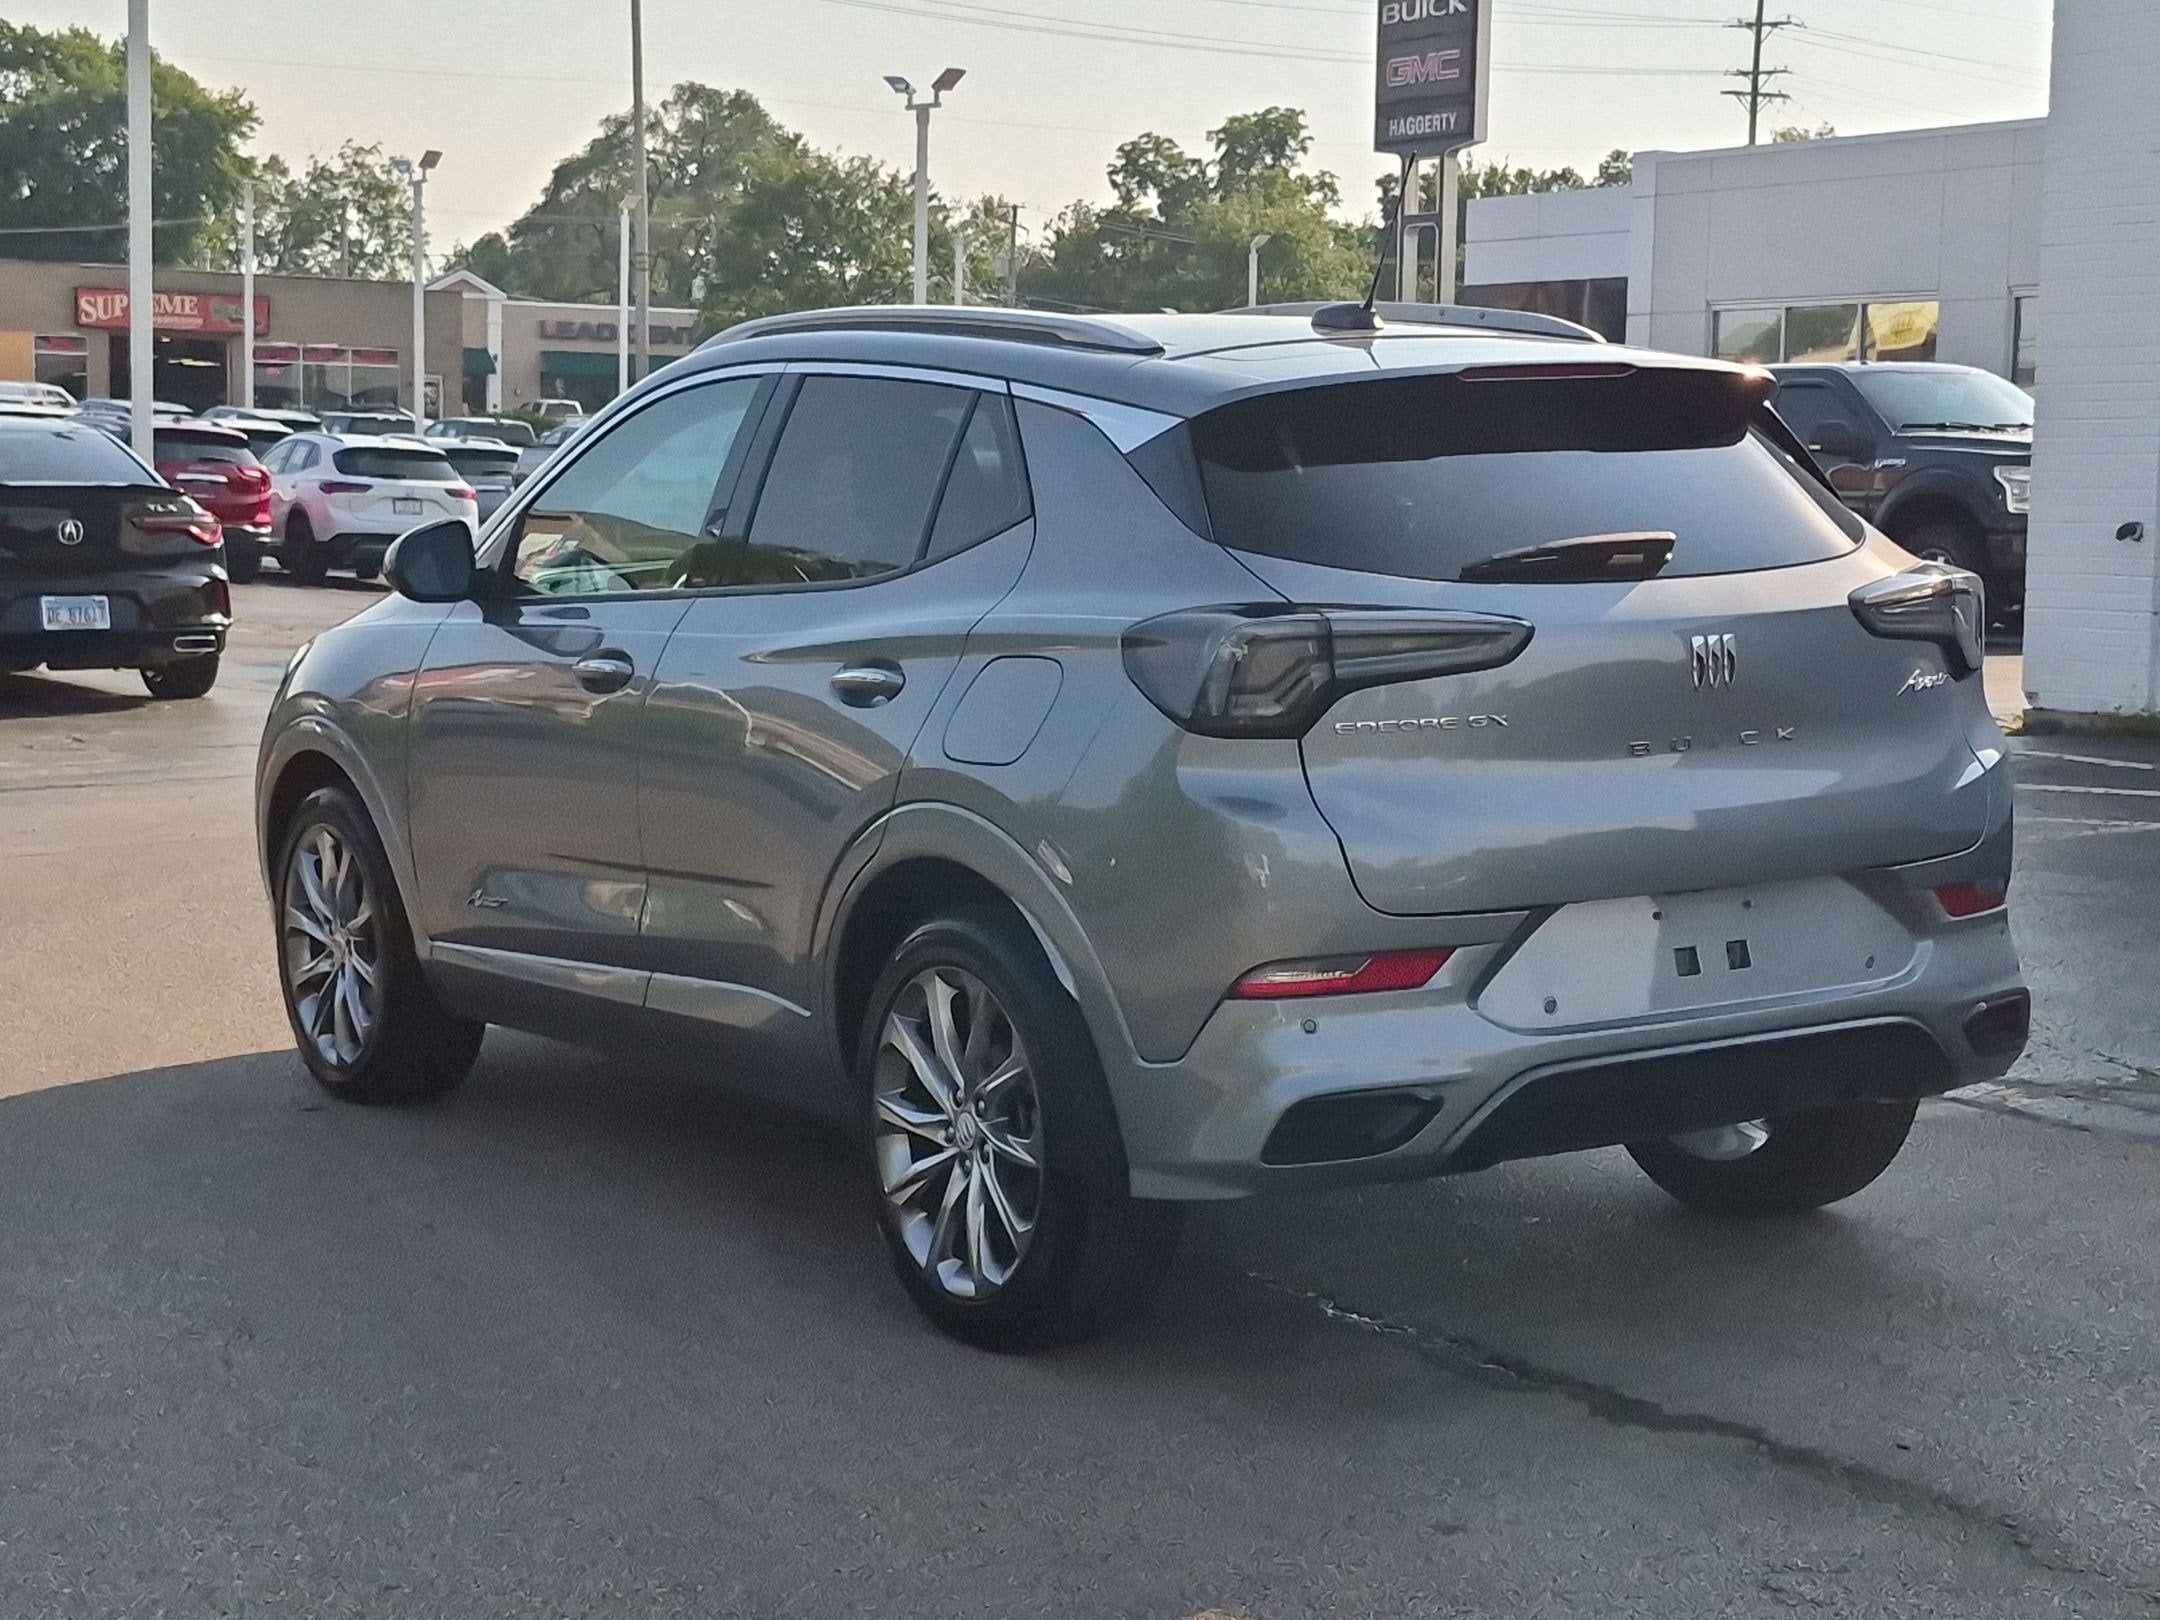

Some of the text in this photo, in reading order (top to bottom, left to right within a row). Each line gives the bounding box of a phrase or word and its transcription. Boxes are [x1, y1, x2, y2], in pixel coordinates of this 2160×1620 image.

[1382, 0, 1468, 25] BUICK
[1386, 48, 1461, 88] GMC
[1388, 112, 1457, 137] HAGGERTY
[79, 294, 199, 323] SUPEME
[1334, 713, 1508, 736] ENCORE GX
[1628, 726, 1796, 757] BUCK
